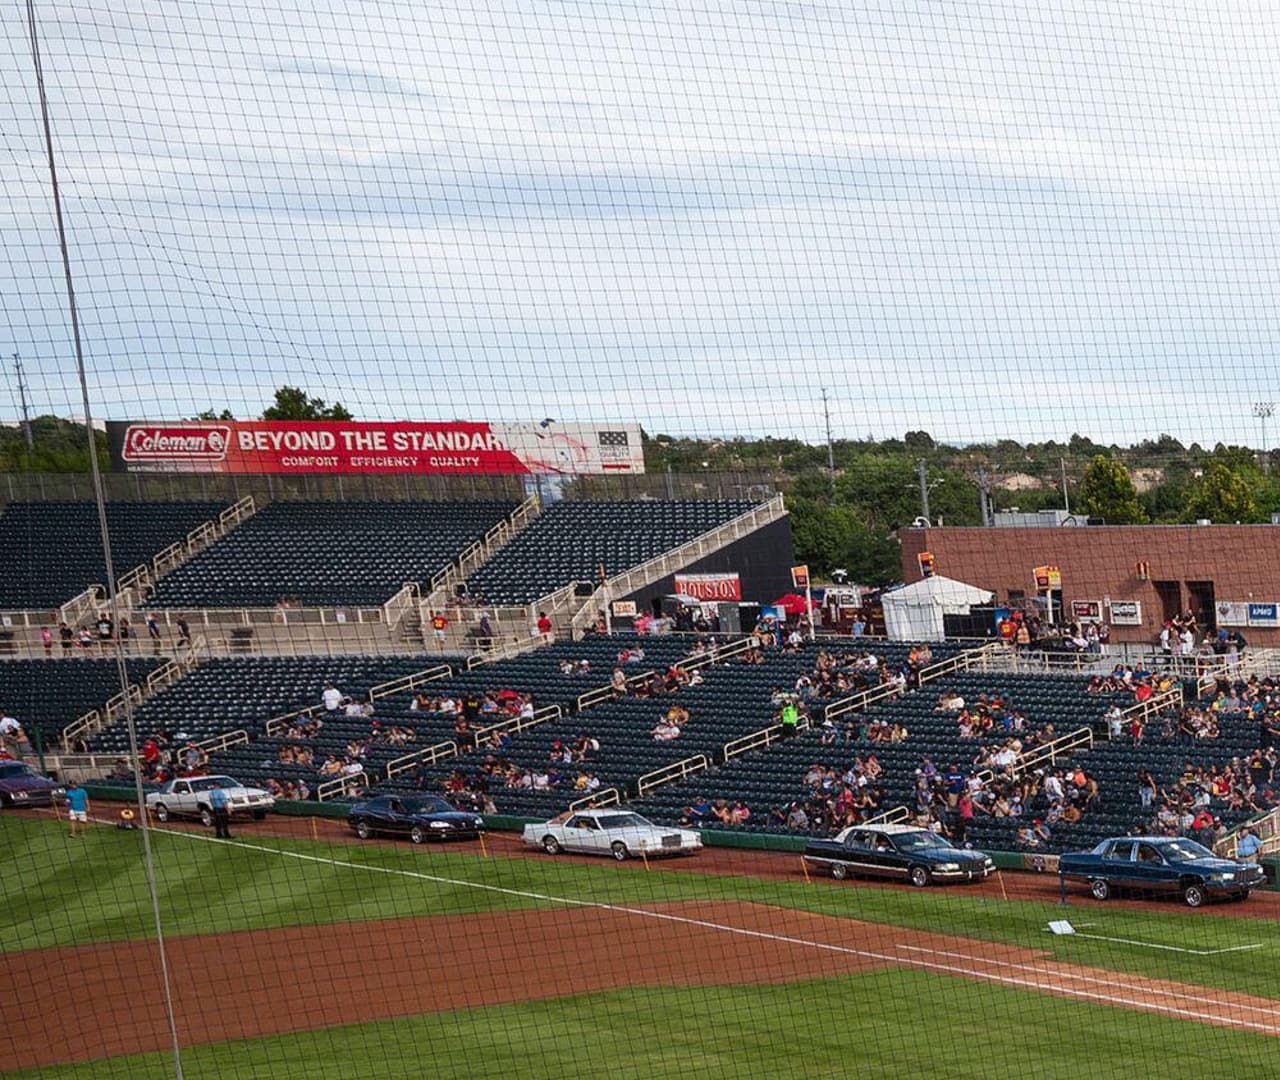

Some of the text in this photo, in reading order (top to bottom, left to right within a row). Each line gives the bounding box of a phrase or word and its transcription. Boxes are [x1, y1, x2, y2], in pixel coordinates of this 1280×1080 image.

[131, 430, 206, 452] Coleman
[238, 431, 503, 451] BEYOND THE STANDAR
[282, 456, 480, 467] COMFORT EFFICIENCY QUALITY
[679, 580, 736, 598] HOUSTON
